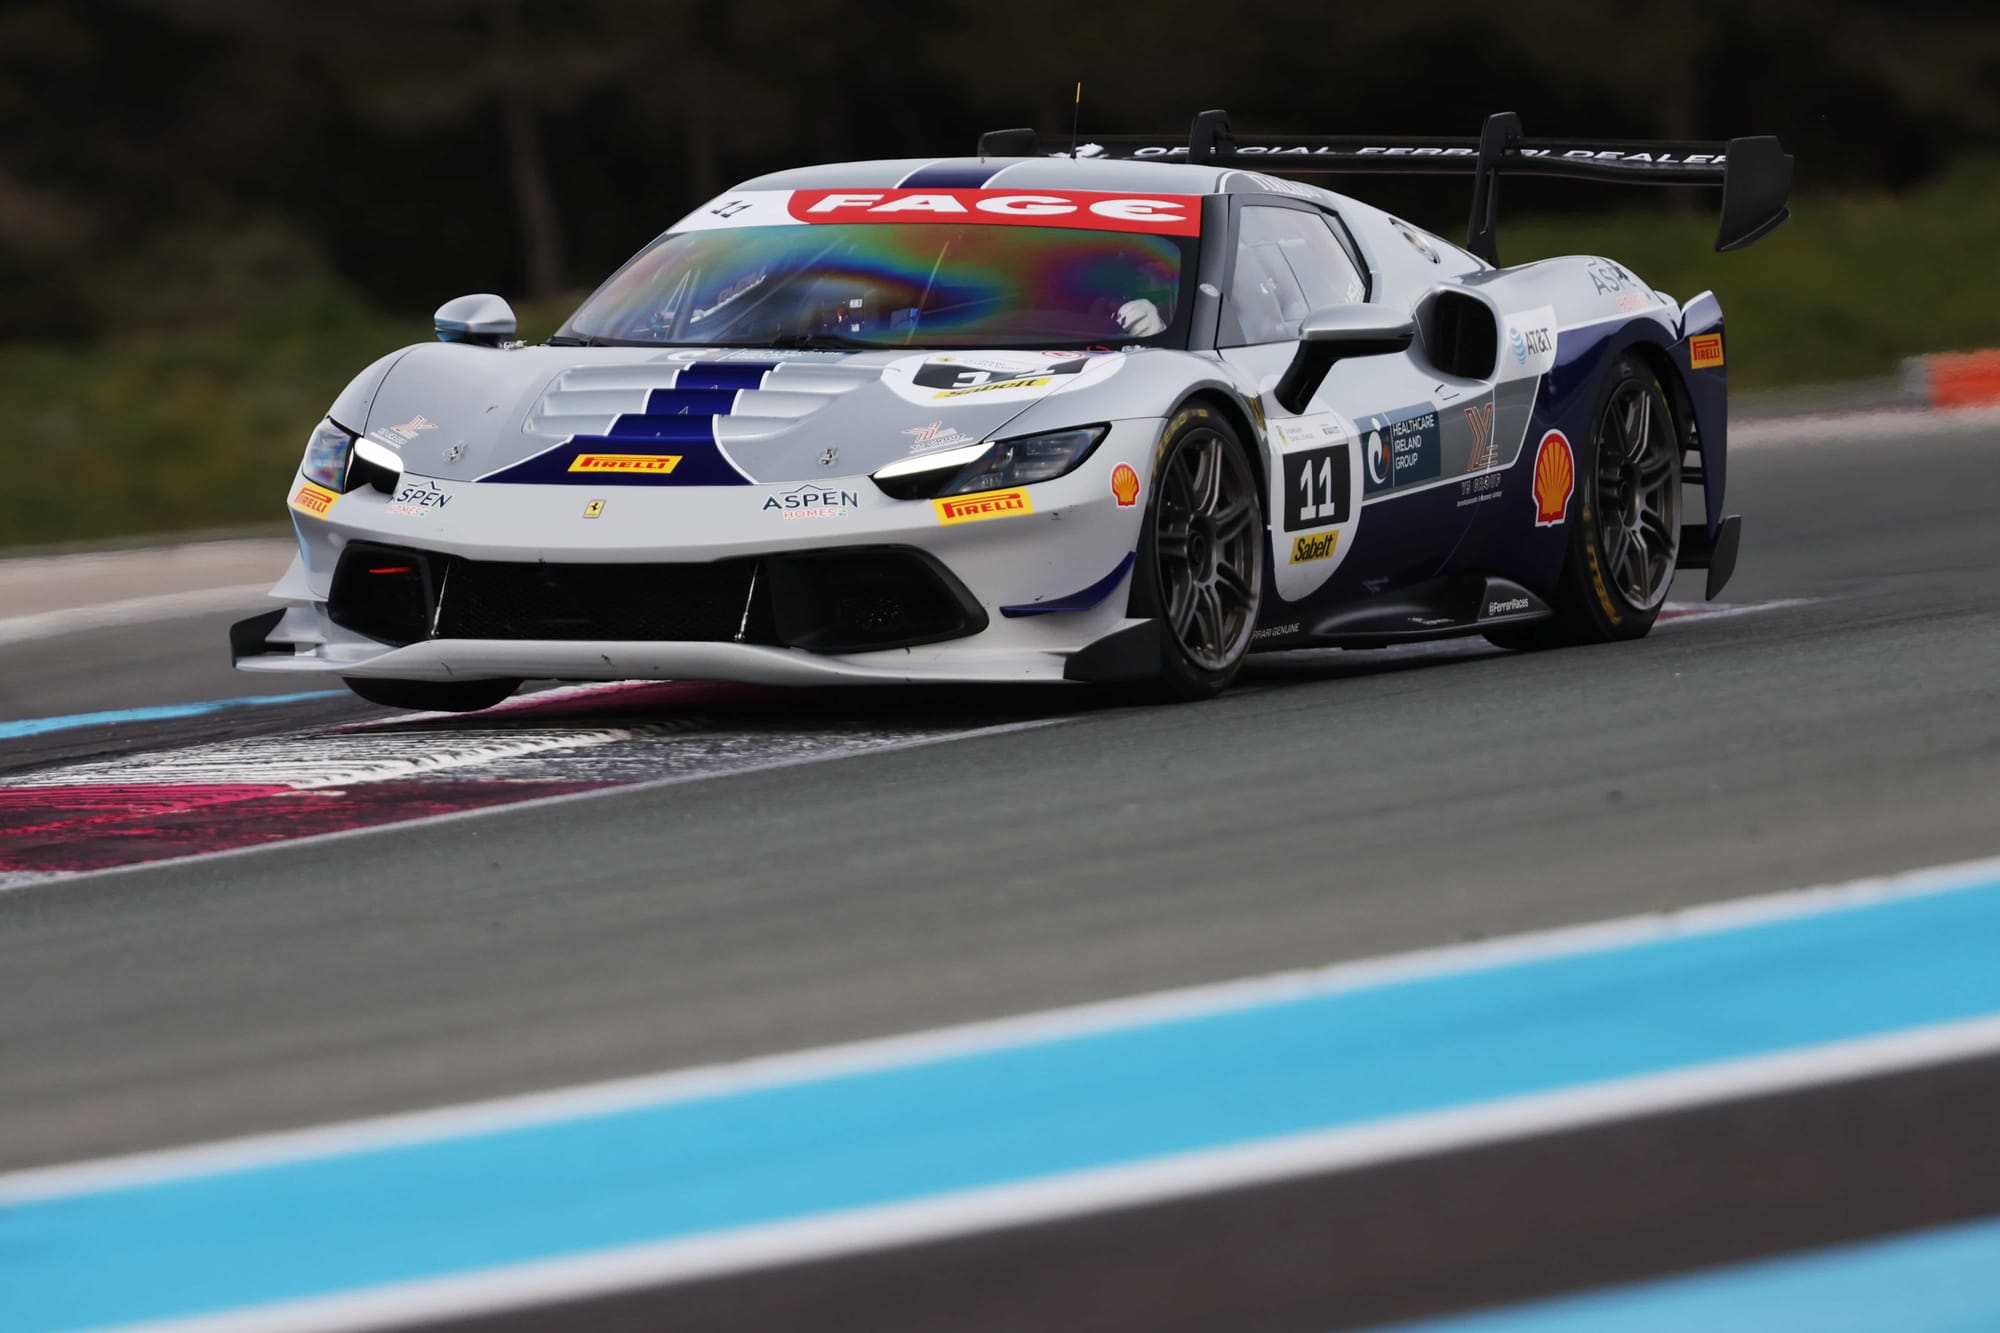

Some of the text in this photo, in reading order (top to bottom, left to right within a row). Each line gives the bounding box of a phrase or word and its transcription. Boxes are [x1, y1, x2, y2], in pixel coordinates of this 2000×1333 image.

[1134, 146, 1336, 156] OFCIAL
[1356, 147, 1551, 157] FERRRI
[710, 200, 753, 219] 11
[806, 194, 1188, 222] FAGE
[1525, 328, 1552, 355] AT&T
[1692, 339, 1721, 361] PIRELLI
[1392, 415, 1435, 436] HEALTHCARE
[1394, 435, 1422, 453] IRELAND
[580, 457, 670, 469] PIRELLI
[1395, 453, 1418, 470] GROUP
[1300, 456, 1335, 521] 11
[293, 487, 333, 513] PIRELLI
[762, 490, 858, 511] ASPEN
[942, 493, 1024, 519] PIRELLI
[783, 508, 836, 519] HOMES
[1294, 533, 1334, 562] Sabelt
